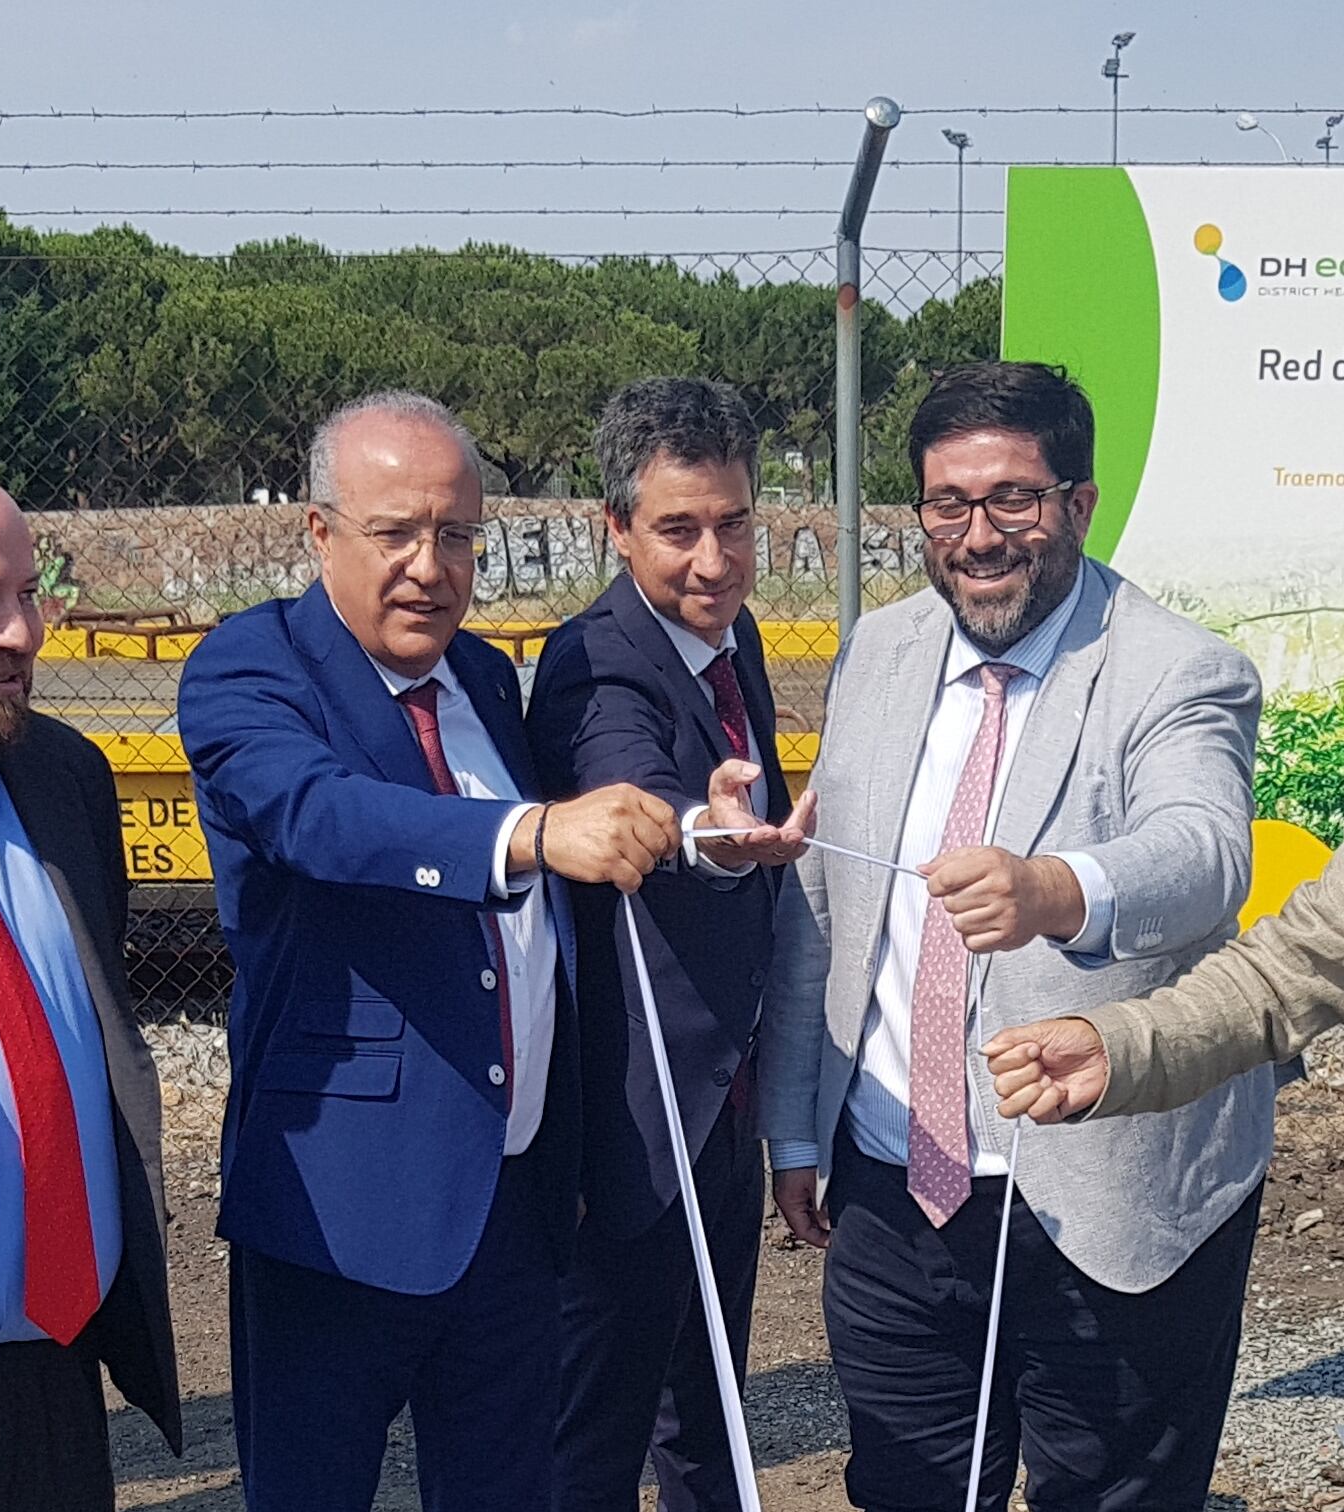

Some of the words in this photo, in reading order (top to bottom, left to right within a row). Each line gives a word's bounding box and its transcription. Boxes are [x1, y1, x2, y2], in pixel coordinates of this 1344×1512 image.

[1259, 257, 1307, 277] DH
[1258, 286, 1319, 297] DISTRICT
[1258, 349, 1323, 381] Red
[147, 798, 192, 827] DE
[130, 844, 174, 874] ES
